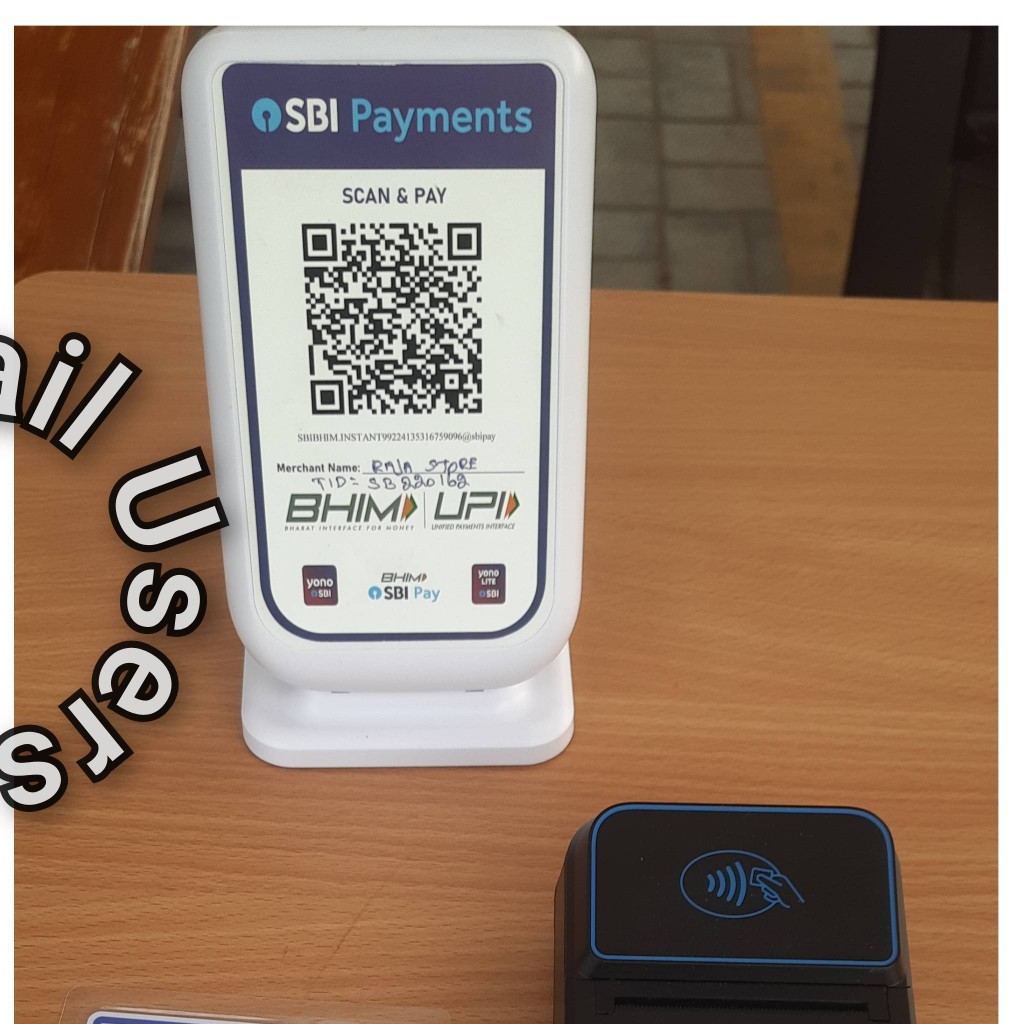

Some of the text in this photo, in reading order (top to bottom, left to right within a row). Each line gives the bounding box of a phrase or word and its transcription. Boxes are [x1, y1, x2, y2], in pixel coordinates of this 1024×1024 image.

[285, 97, 533, 143] SBI Payments
[342, 187, 447, 204] SCAN & PAY
[277, 462, 361, 474] Merchant Name:
[285, 493, 403, 522] BHIM
[433, 491, 507, 520] UPI
[381, 572, 421, 583] BHIM
[478, 569, 500, 578] yono
[306, 578, 334, 589] yono
[481, 578, 496, 586] LITE
[318, 589, 332, 598] SBI
[384, 586, 441, 602] SBI Pay
[486, 590, 500, 598] SBI
